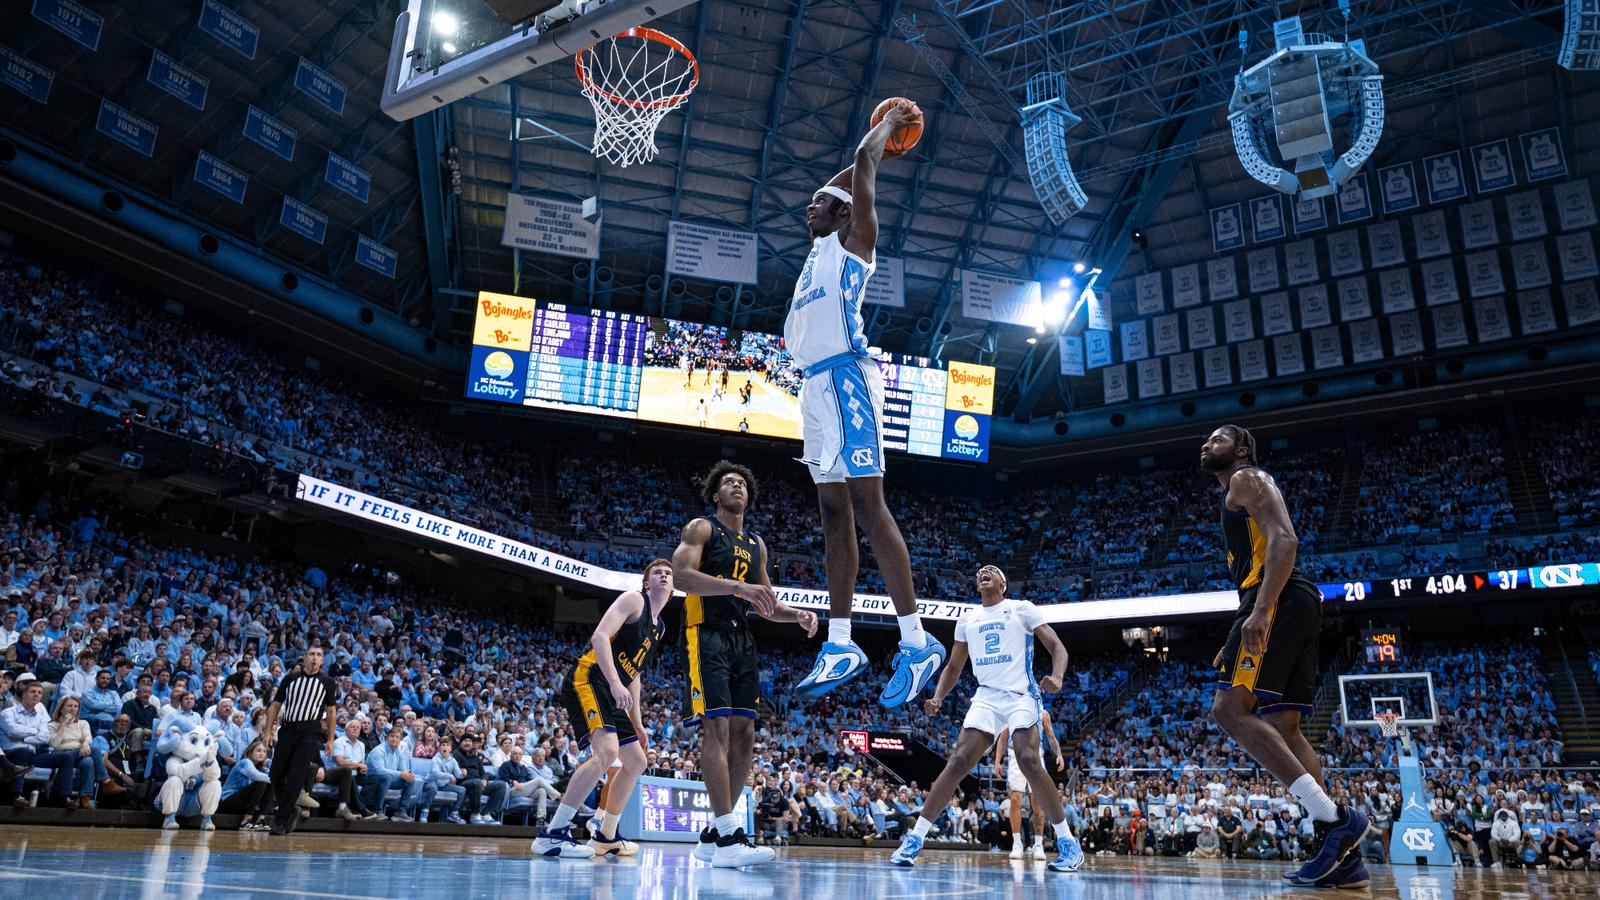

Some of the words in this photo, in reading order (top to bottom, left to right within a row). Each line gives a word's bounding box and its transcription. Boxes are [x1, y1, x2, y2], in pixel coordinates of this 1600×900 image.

[482, 300, 532, 320] Bojangles
[548, 303, 566, 312] PLAYER
[621, 313, 630, 321] AST
[882, 363, 896, 380] 20
[951, 369, 992, 386] Bojangles
[474, 382, 519, 399] Lottery
[947, 443, 984, 458] Lottery
[309, 485, 330, 499] IF
[335, 491, 354, 507] IT
[360, 500, 412, 524] FEELS
[416, 516, 453, 537] LIKE
[456, 530, 496, 550] MORE
[501, 543, 539, 563] THAN
[541, 556, 551, 567] A
[555, 560, 589, 578] GAME
[734, 545, 751, 562] EAST
[732, 558, 748, 582] 12
[1344, 582, 1365, 602] 20
[1391, 578, 1412, 596] 1ST
[1425, 574, 1466, 595] 4:04
[1498, 570, 1518, 590] 37
[979, 622, 1005, 633] NORTH
[985, 633, 1000, 654] 2
[1373, 634, 1396, 644] 4:04
[976, 654, 1012, 666] CAROLINA
[1379, 644, 1395, 662] 19
[657, 789, 669, 805] 20
[693, 793, 710, 808] 4:04
